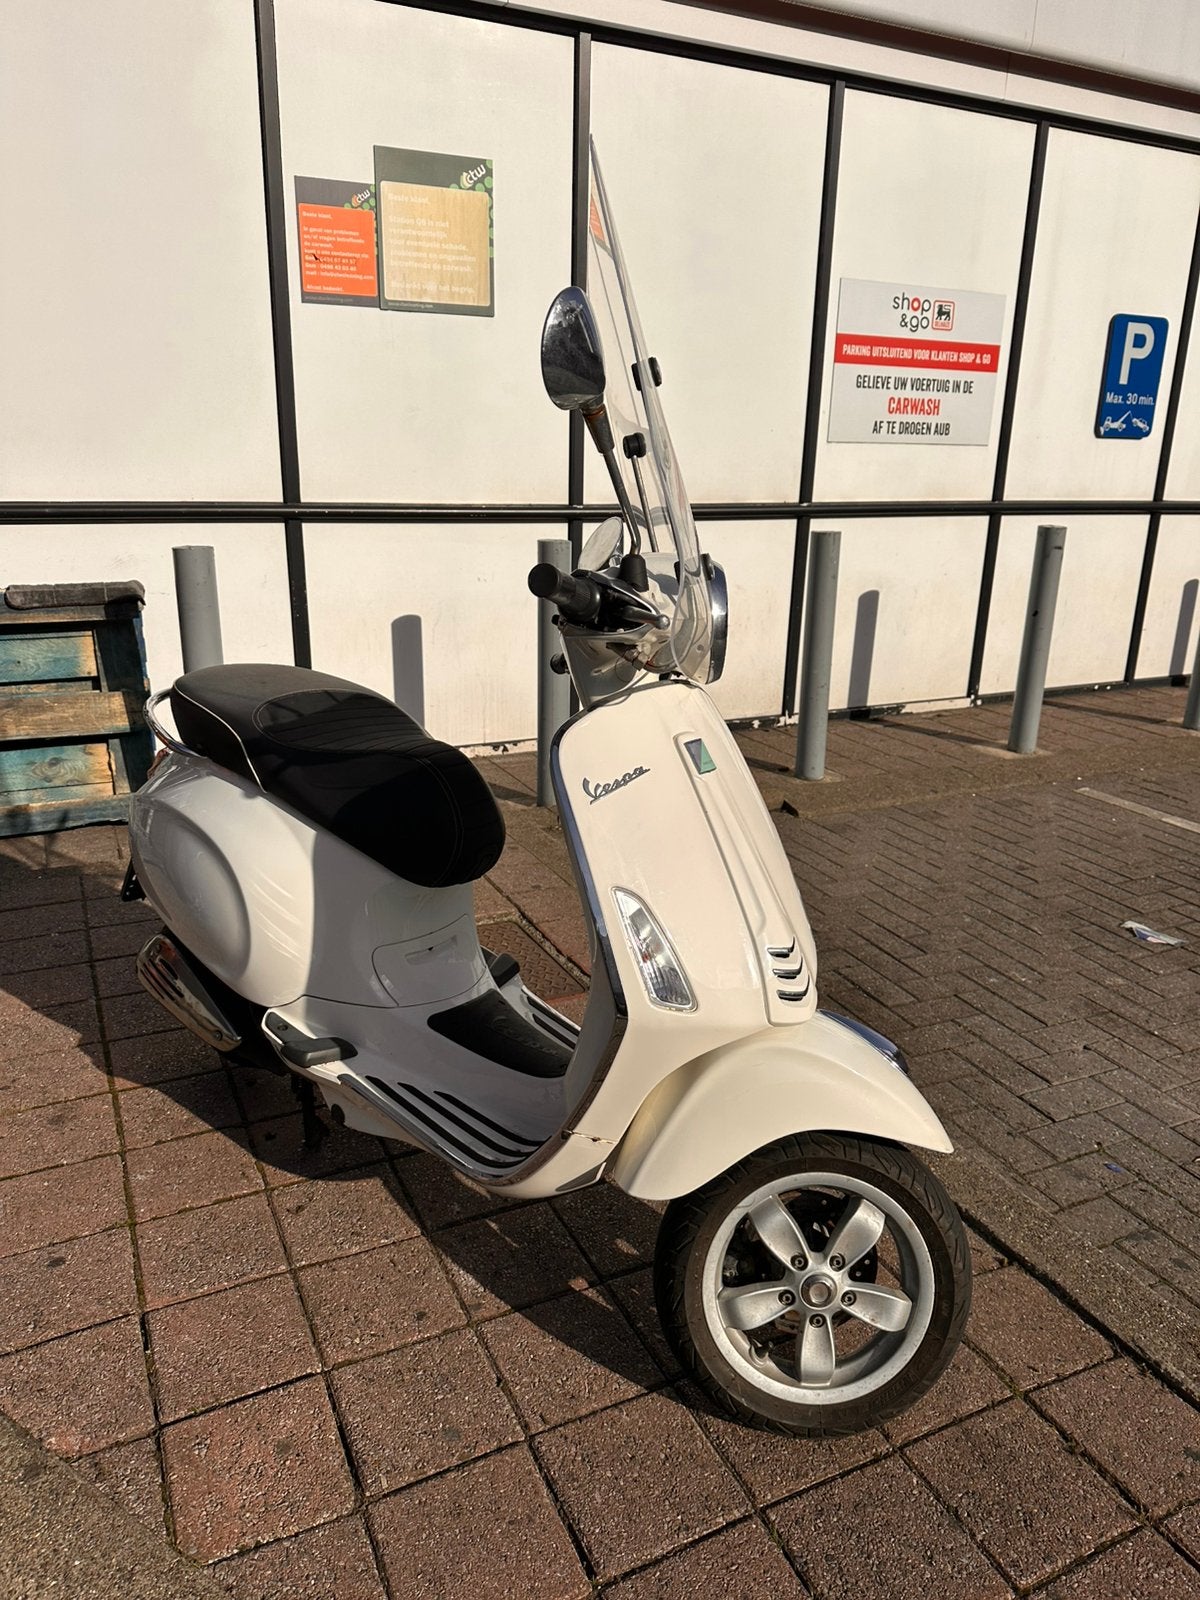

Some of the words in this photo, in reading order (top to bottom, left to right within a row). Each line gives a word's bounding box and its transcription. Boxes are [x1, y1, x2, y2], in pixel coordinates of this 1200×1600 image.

[464, 164, 486, 185] ctw
[893, 292, 931, 316] shop
[899, 313, 930, 332] &go
[842, 344, 871, 357] PARKING
[872, 346, 913, 360] UITSLUITEND
[913, 348, 930, 361] VOOR
[931, 350, 958, 362] KLANTEN
[959, 352, 975, 364] SHOP
[975, 353, 982, 364] &
[982, 354, 991, 365] GO
[1118, 321, 1155, 385] P
[856, 374, 892, 390] GELIEVE
[893, 376, 908, 391] UW
[909, 377, 951, 394] VOERTUIG
[951, 380, 961, 394] IN
[962, 380, 974, 394] DE
[888, 396, 941, 416] CARWASH
[1105, 392, 1125, 404] Max.
[1126, 393, 1138, 405] 30
[1138, 394, 1155, 405] min.
[872, 420, 884, 434] AF
[886, 421, 896, 434] TE
[898, 421, 932, 436] DROGEN
[933, 422, 951, 436] AUB
[582, 766, 651, 805] Vespa
